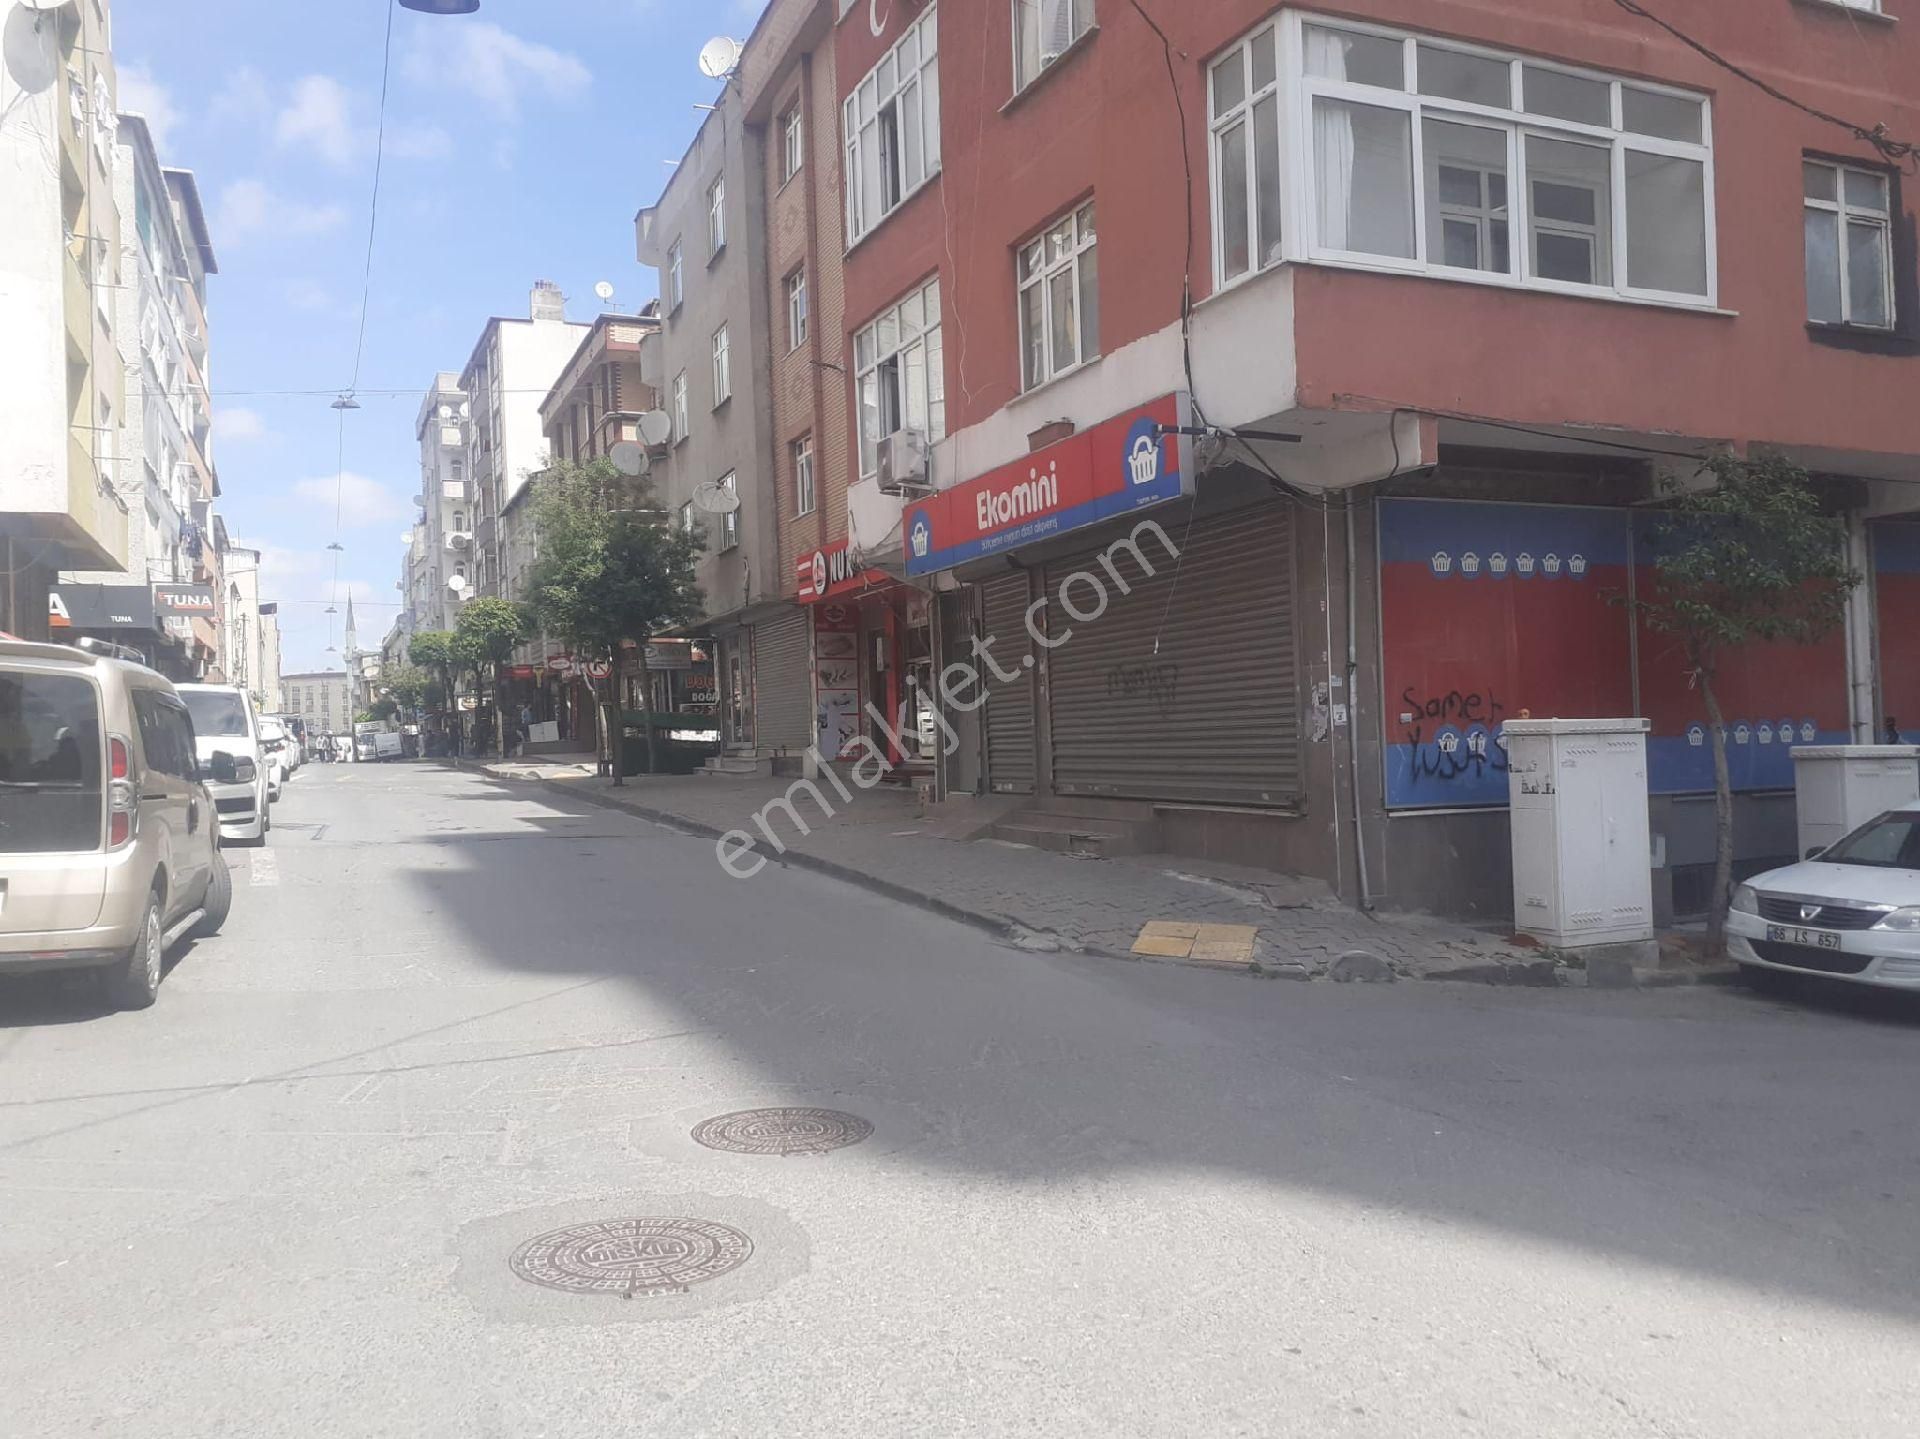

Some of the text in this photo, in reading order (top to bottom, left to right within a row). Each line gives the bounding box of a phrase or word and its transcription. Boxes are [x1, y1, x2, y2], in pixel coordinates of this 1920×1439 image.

[976, 460, 1058, 531] Ekomini
[164, 594, 213, 606] TUNA
[110, 615, 133, 623] TUNA
